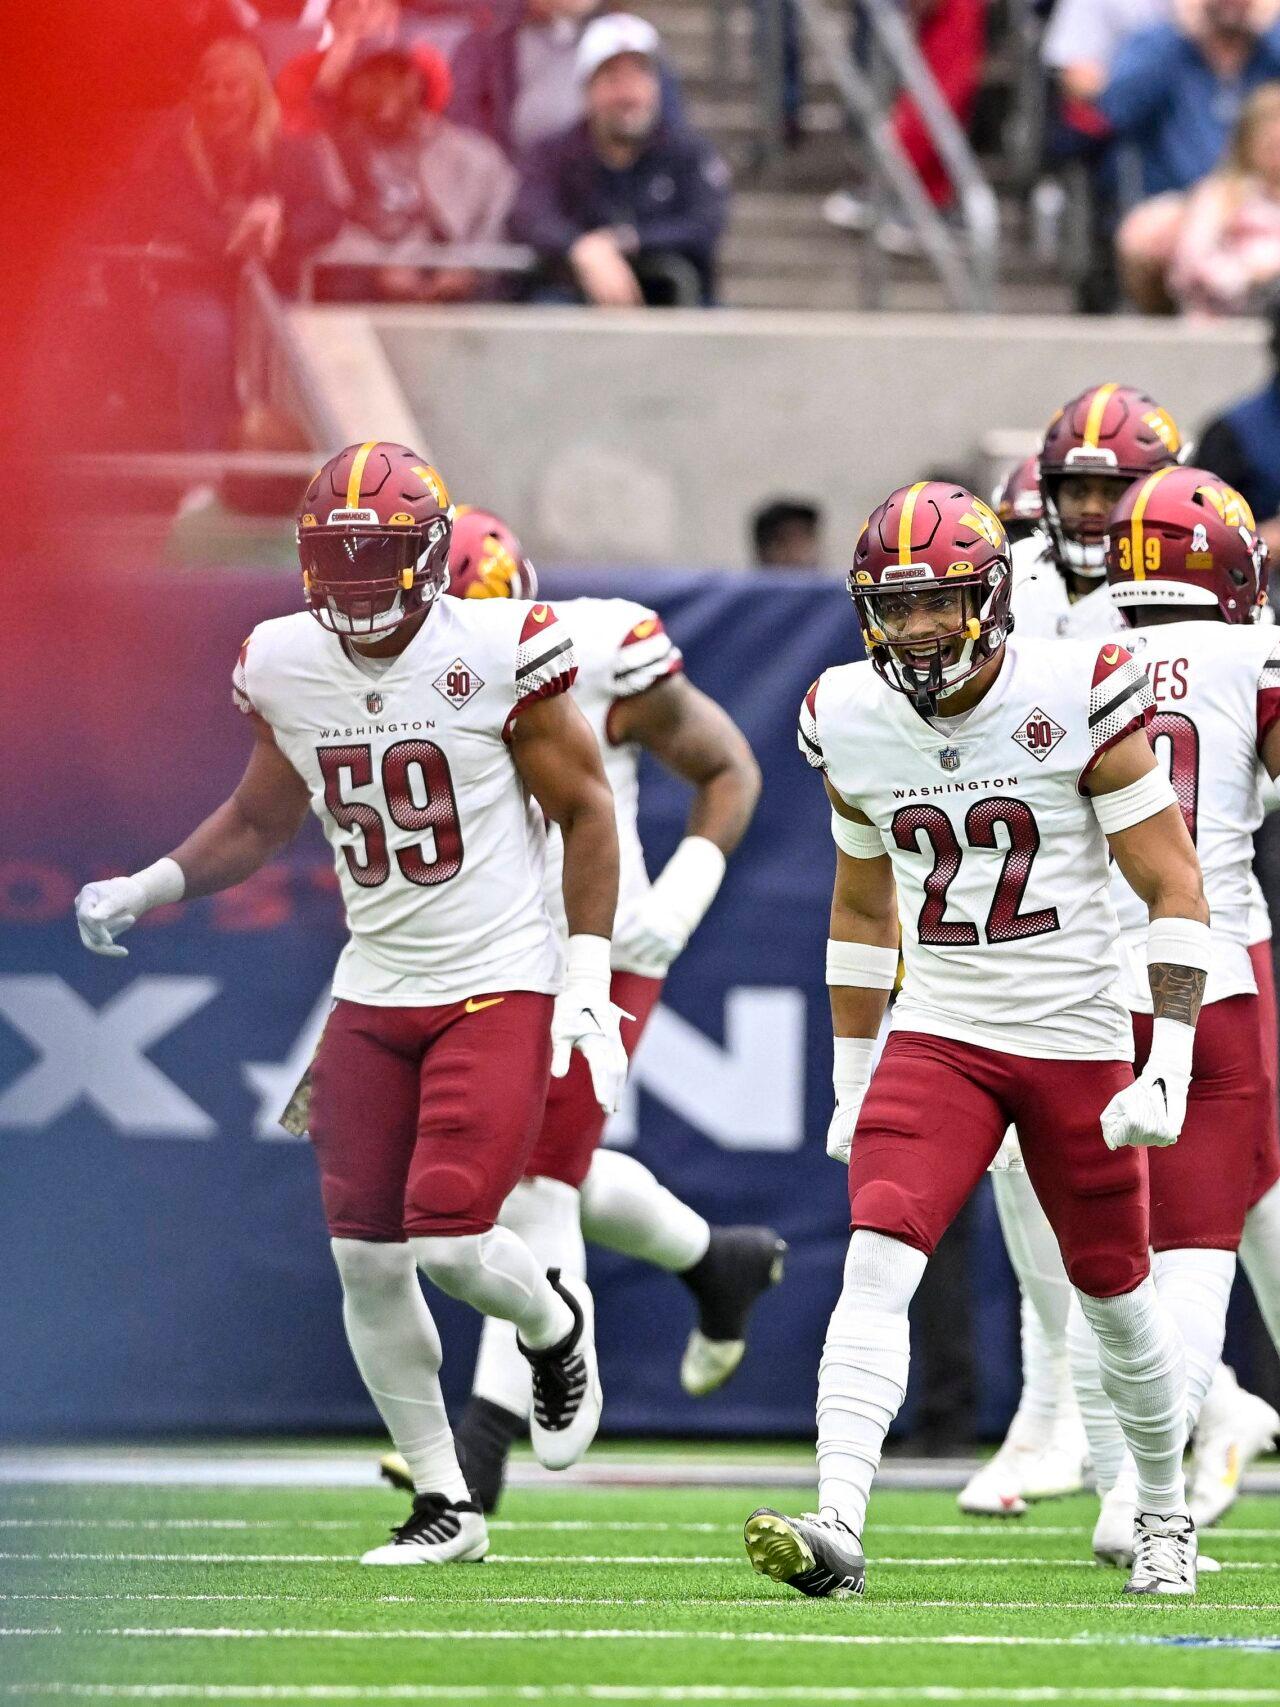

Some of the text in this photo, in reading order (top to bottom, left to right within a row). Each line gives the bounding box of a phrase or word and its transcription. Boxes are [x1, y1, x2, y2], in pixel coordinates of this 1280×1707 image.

[1118, 536, 1161, 571] 39
[446, 671, 471, 697] 90
[319, 720, 437, 739] WASHINGTON
[1026, 720, 1052, 749] 90
[892, 776, 1019, 799] WASHINGTON
[315, 738, 465, 889] 59
[891, 796, 1061, 946] 22
